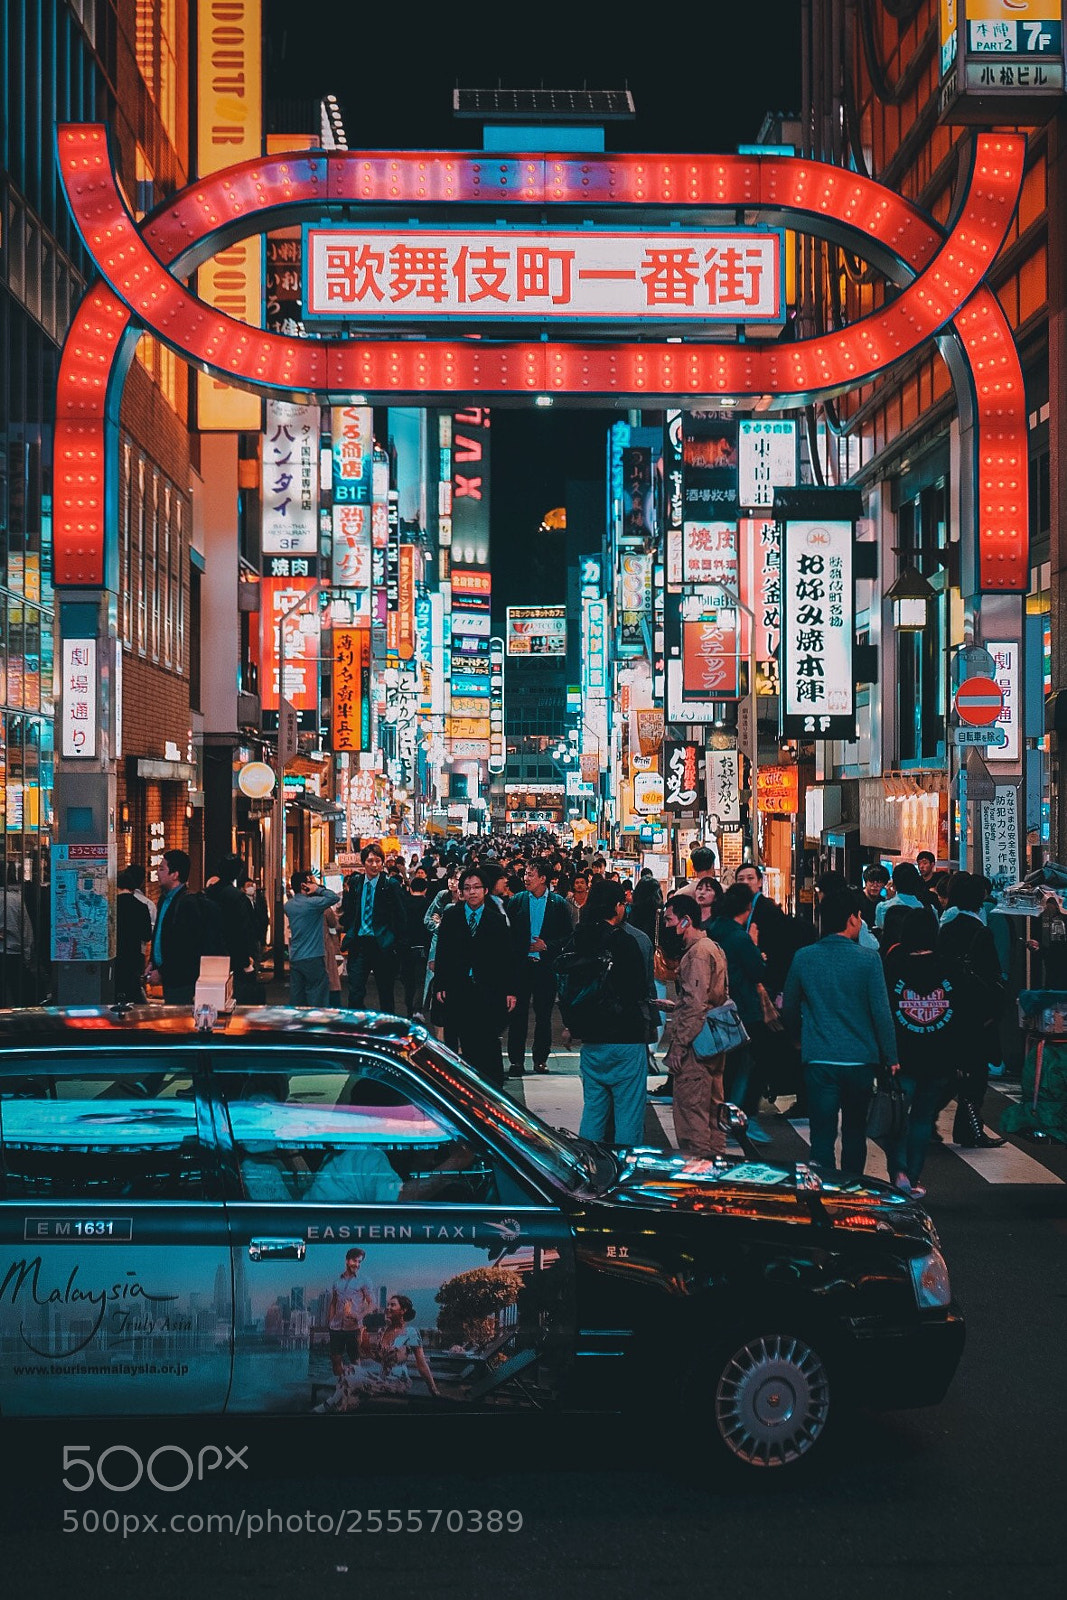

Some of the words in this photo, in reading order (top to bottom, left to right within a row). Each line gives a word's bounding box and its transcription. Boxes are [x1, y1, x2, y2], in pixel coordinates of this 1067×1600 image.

[1022, 22, 1052, 51] 7F
[980, 66, 1048, 86] 小松ビル
[325, 243, 764, 306] 歌舞伎町一番街
[270, 424, 295, 517] バンタイ
[336, 487, 367, 500] B1F
[280, 539, 300, 549] 3F
[70, 648, 88, 746] 劇場通り
[804, 716, 831, 732] 2F
[958, 732, 1001, 743] 自転車を除く
[75, 1222, 114, 1236] 1631
[307, 1226, 412, 1239] EASTERN
[425, 1226, 476, 1238] TAXI
[606, 1245, 629, 1258] 足立
[0, 1256, 179, 1358] Malaysia
[112, 1310, 156, 1334] Truly
[161, 1317, 192, 1331] Asia
[14, 1362, 189, 1377] www.tourismmalaysia.or.jp
